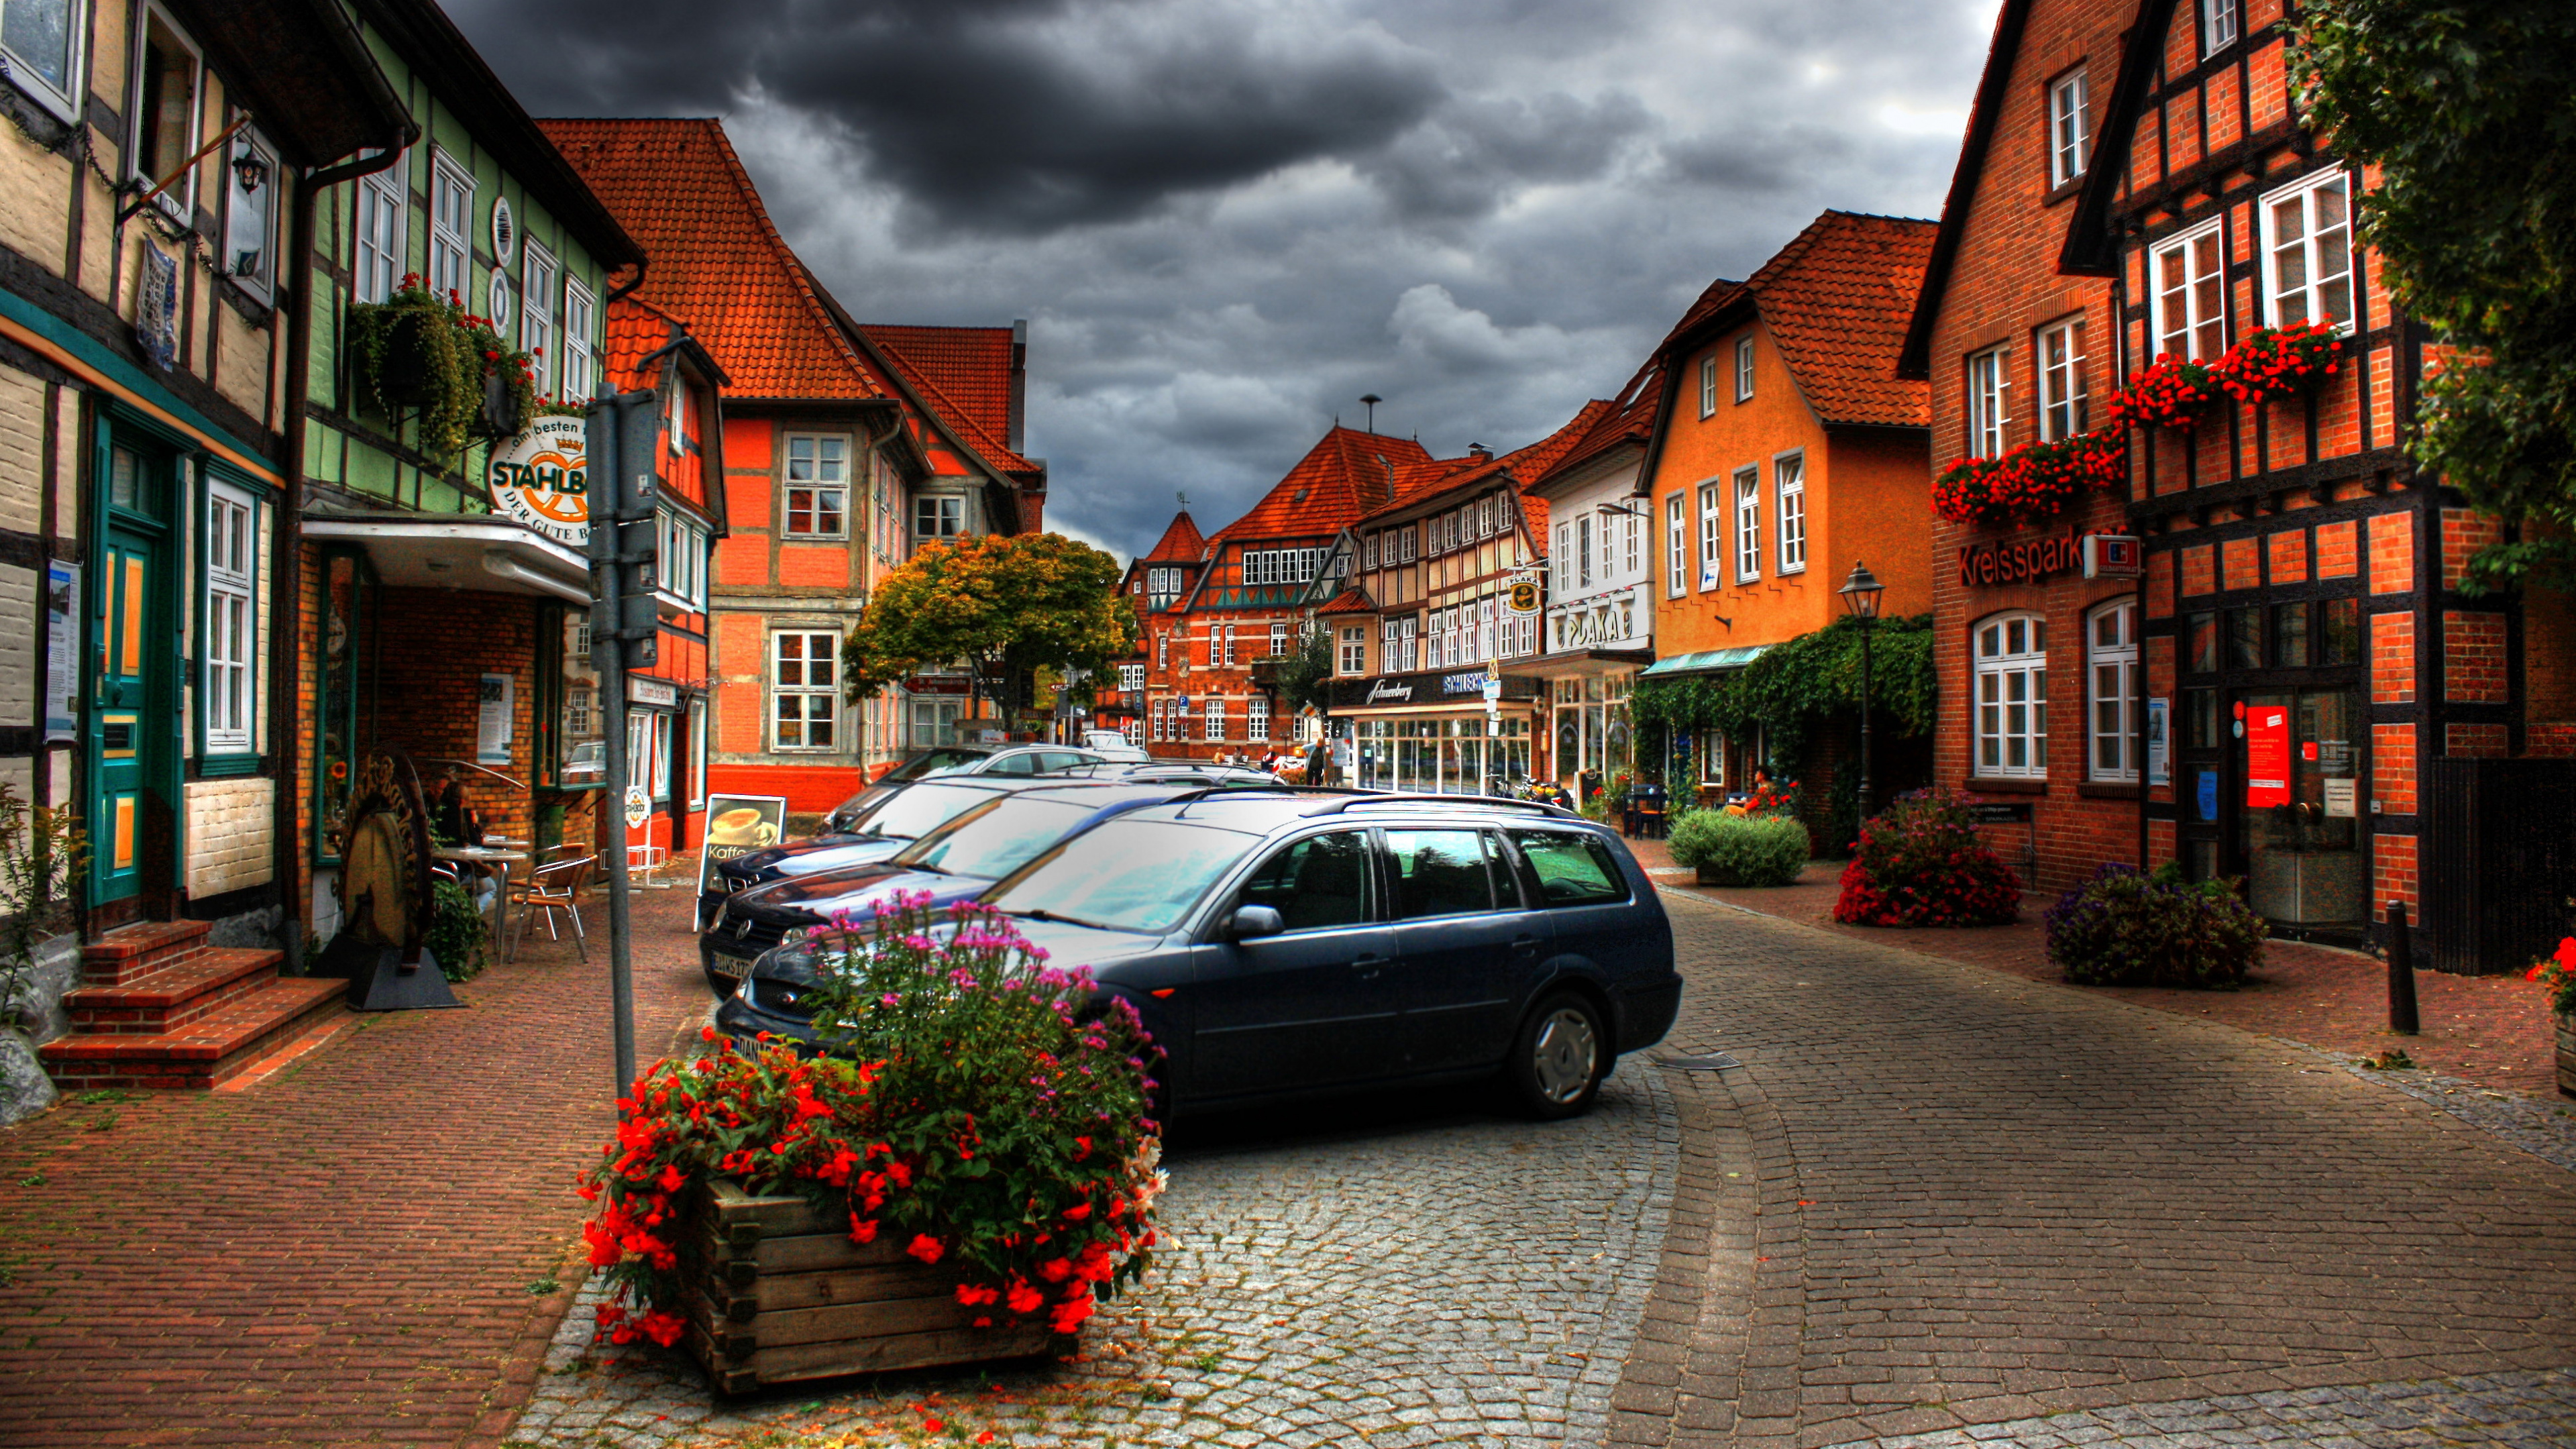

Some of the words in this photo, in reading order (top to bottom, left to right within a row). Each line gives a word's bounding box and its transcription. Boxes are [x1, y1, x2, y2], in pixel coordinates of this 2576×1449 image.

[534, 422, 578, 435] besten
[493, 462, 587, 494] STAHLB
[504, 491, 529, 521] DER
[533, 519, 573, 539] GUTE
[1958, 525, 2128, 587] Kreisspark
[2099, 565, 2138, 573] GELDAUTOMAT
[1569, 610, 1619, 647] PLAKA
[1181, 697, 1186, 705] P
